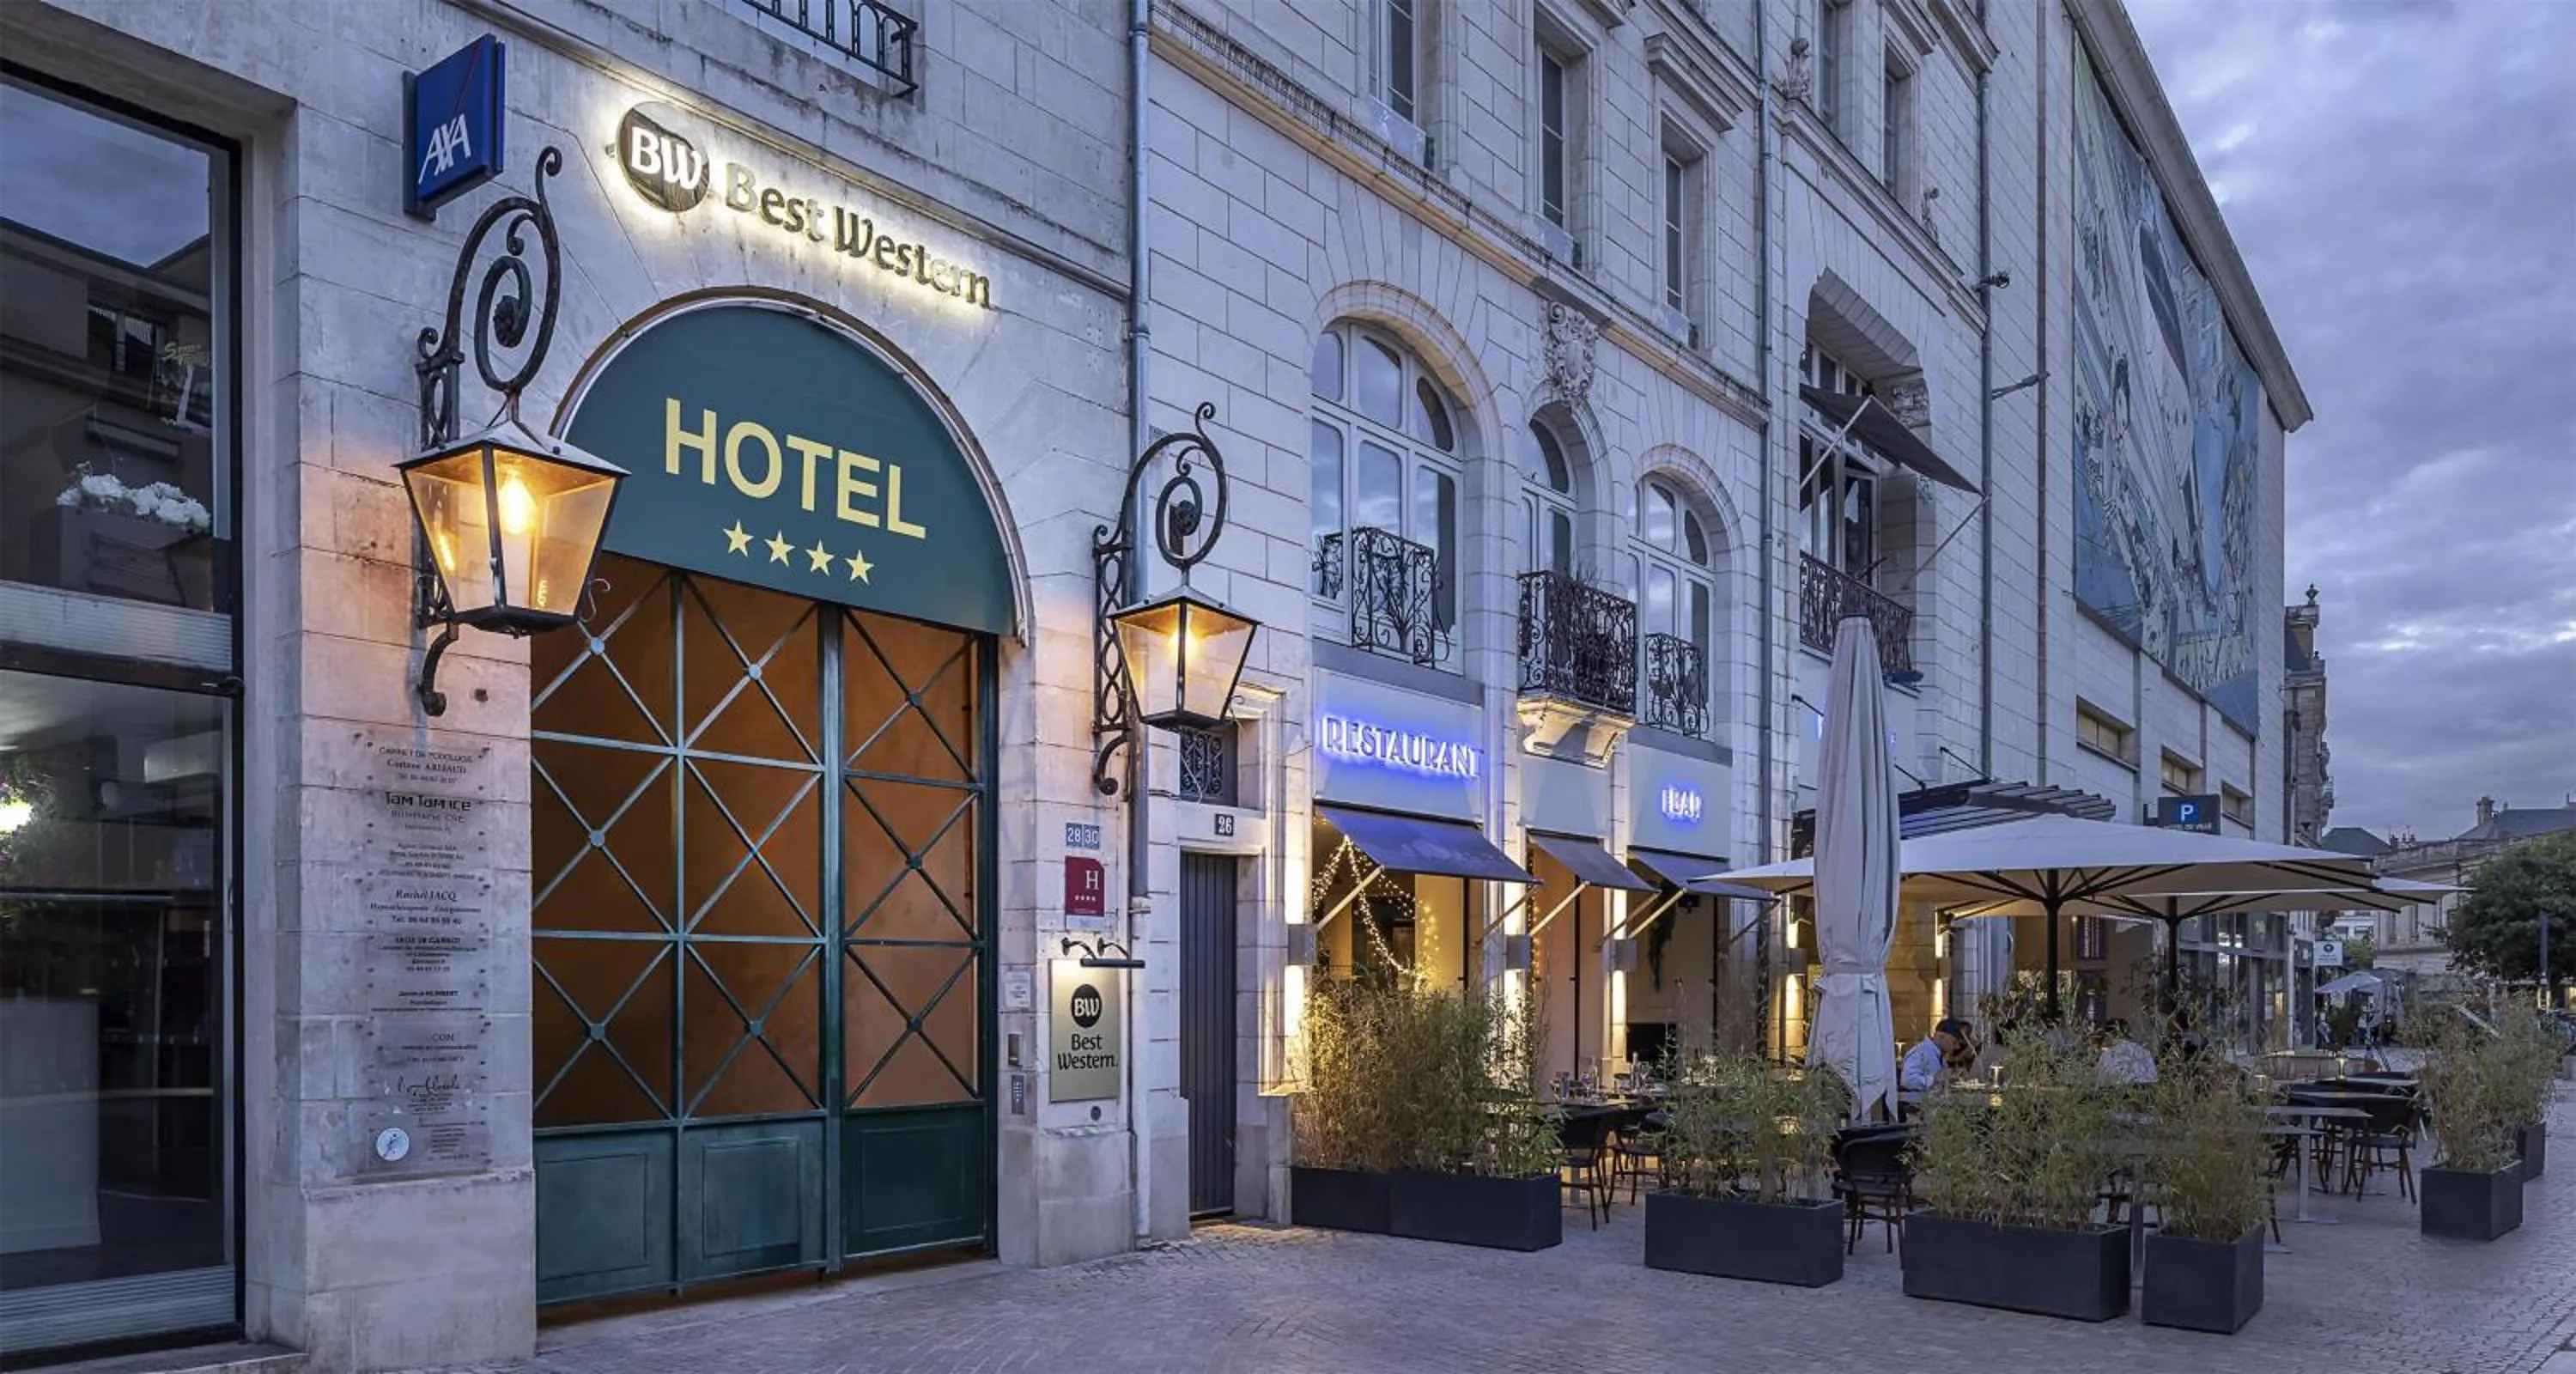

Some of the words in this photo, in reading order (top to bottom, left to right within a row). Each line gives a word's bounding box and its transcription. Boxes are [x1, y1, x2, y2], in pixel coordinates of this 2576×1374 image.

[418, 112, 471, 185] AXA
[630, 125, 702, 191] BW
[726, 161, 825, 243] Best
[833, 205, 990, 310] Western
[665, 397, 927, 539] HOTEL
[1321, 715, 1485, 778] RESTAURANT
[2180, 804, 2195, 822] P
[1067, 827, 1082, 844] 28
[1218, 818, 1233, 835] 26
[1085, 870, 1100, 891] H
[1073, 997, 1101, 1018] BW
[1071, 1033, 1103, 1050] Best
